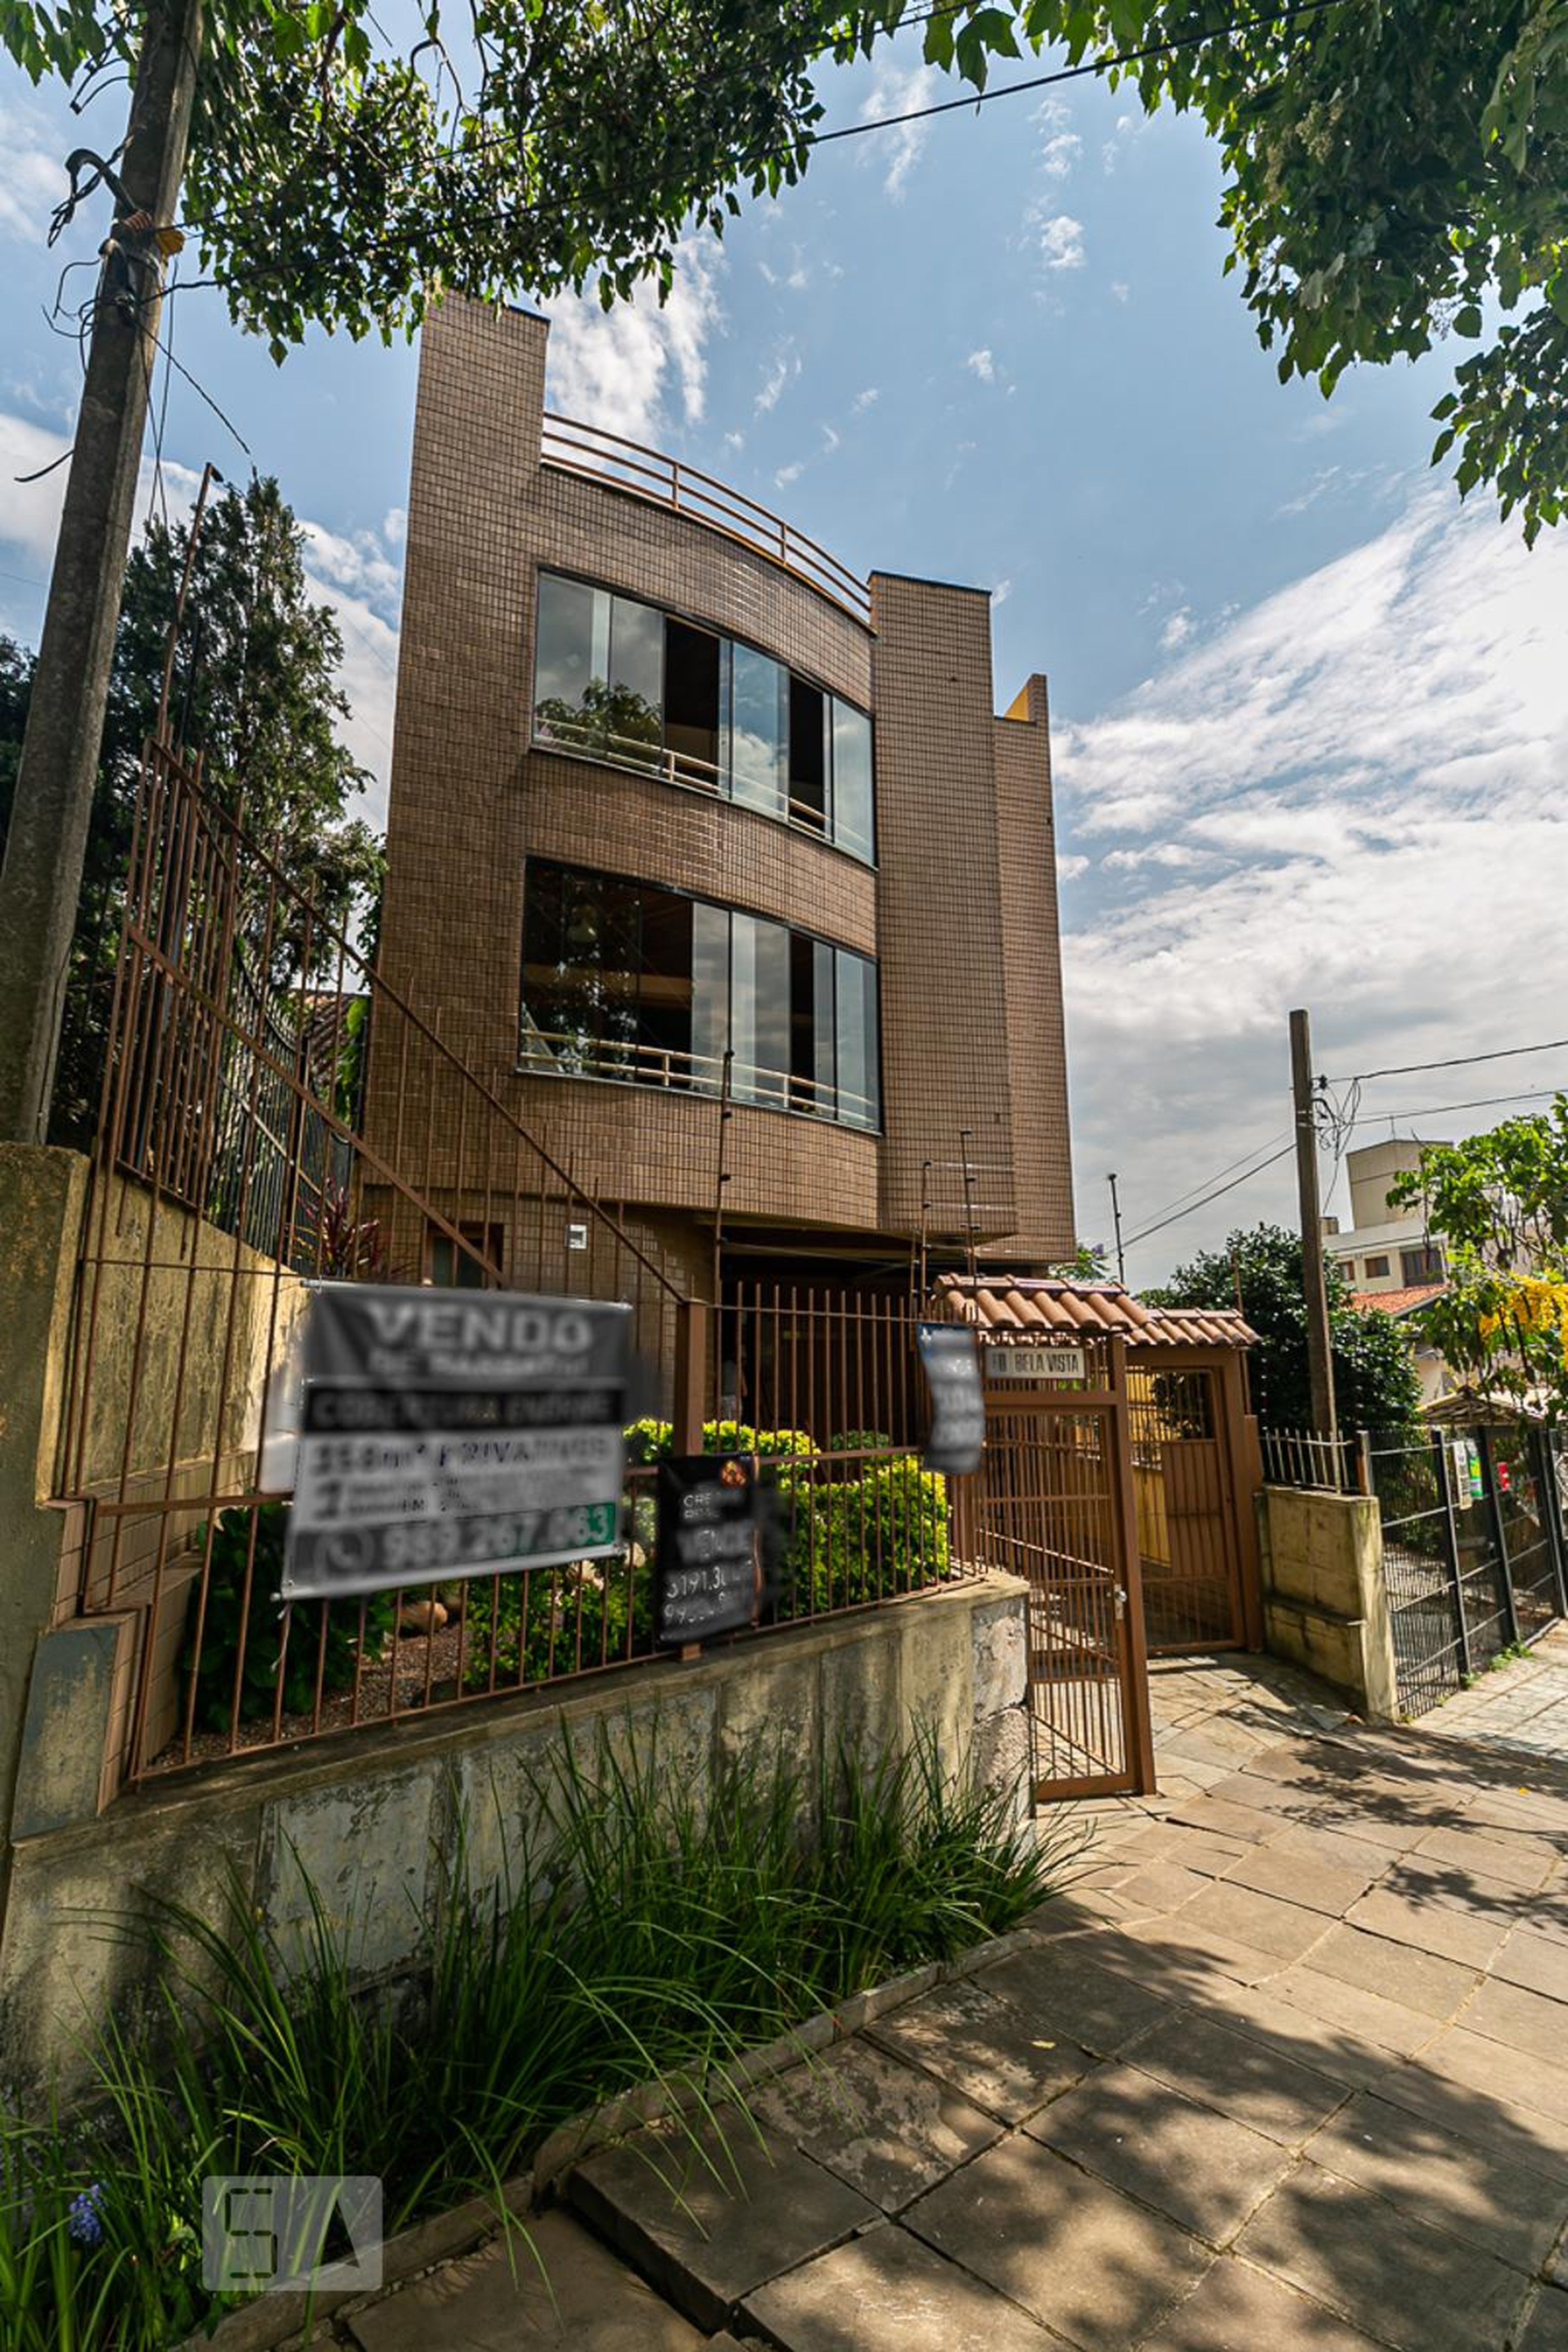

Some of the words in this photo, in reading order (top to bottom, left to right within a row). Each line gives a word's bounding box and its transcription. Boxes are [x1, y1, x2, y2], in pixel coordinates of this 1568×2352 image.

[366, 1303, 593, 1352] VENDO
[1015, 1353, 1045, 1372] BELA
[1047, 1354, 1079, 1372] VISTA
